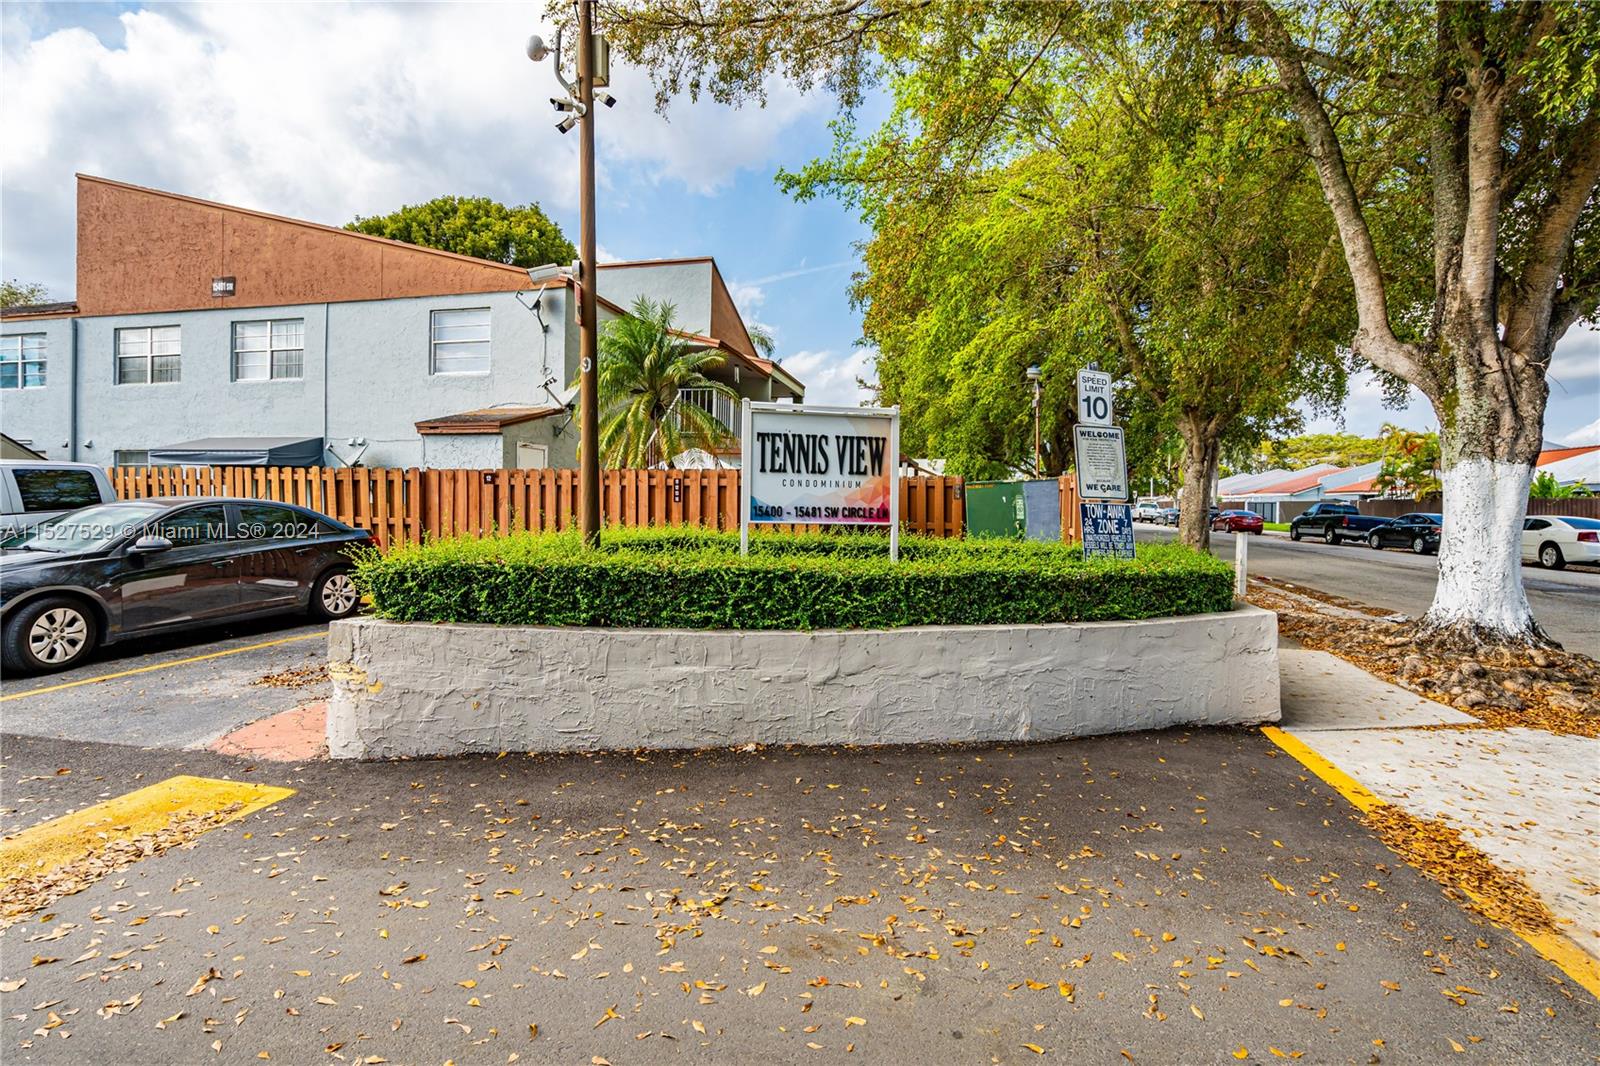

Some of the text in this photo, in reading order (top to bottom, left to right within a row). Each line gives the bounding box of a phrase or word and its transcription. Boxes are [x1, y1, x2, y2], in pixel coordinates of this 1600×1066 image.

[1081, 375, 1108, 386] SPEED
[1084, 385, 1105, 394] LIMIT
[1082, 395, 1109, 420] 10
[1079, 430, 1120, 440] WELCOME
[756, 431, 887, 477] TENNIS VIEW
[782, 478, 862, 489] CONDOMINIUM
[1086, 483, 1122, 492] WE CARE
[753, 505, 783, 518] 15400
[794, 506, 822, 519] 15481
[824, 506, 840, 519] SW
[841, 507, 874, 520] CIRCLE
[876, 508, 889, 520] LN
[1085, 504, 1126, 519] TOW-AWAY
[1085, 518, 1093, 526] 24
[1097, 519, 1120, 534] ZONE
[1124, 519, 1128, 527] 7
[1084, 526, 1095, 534] HRS
